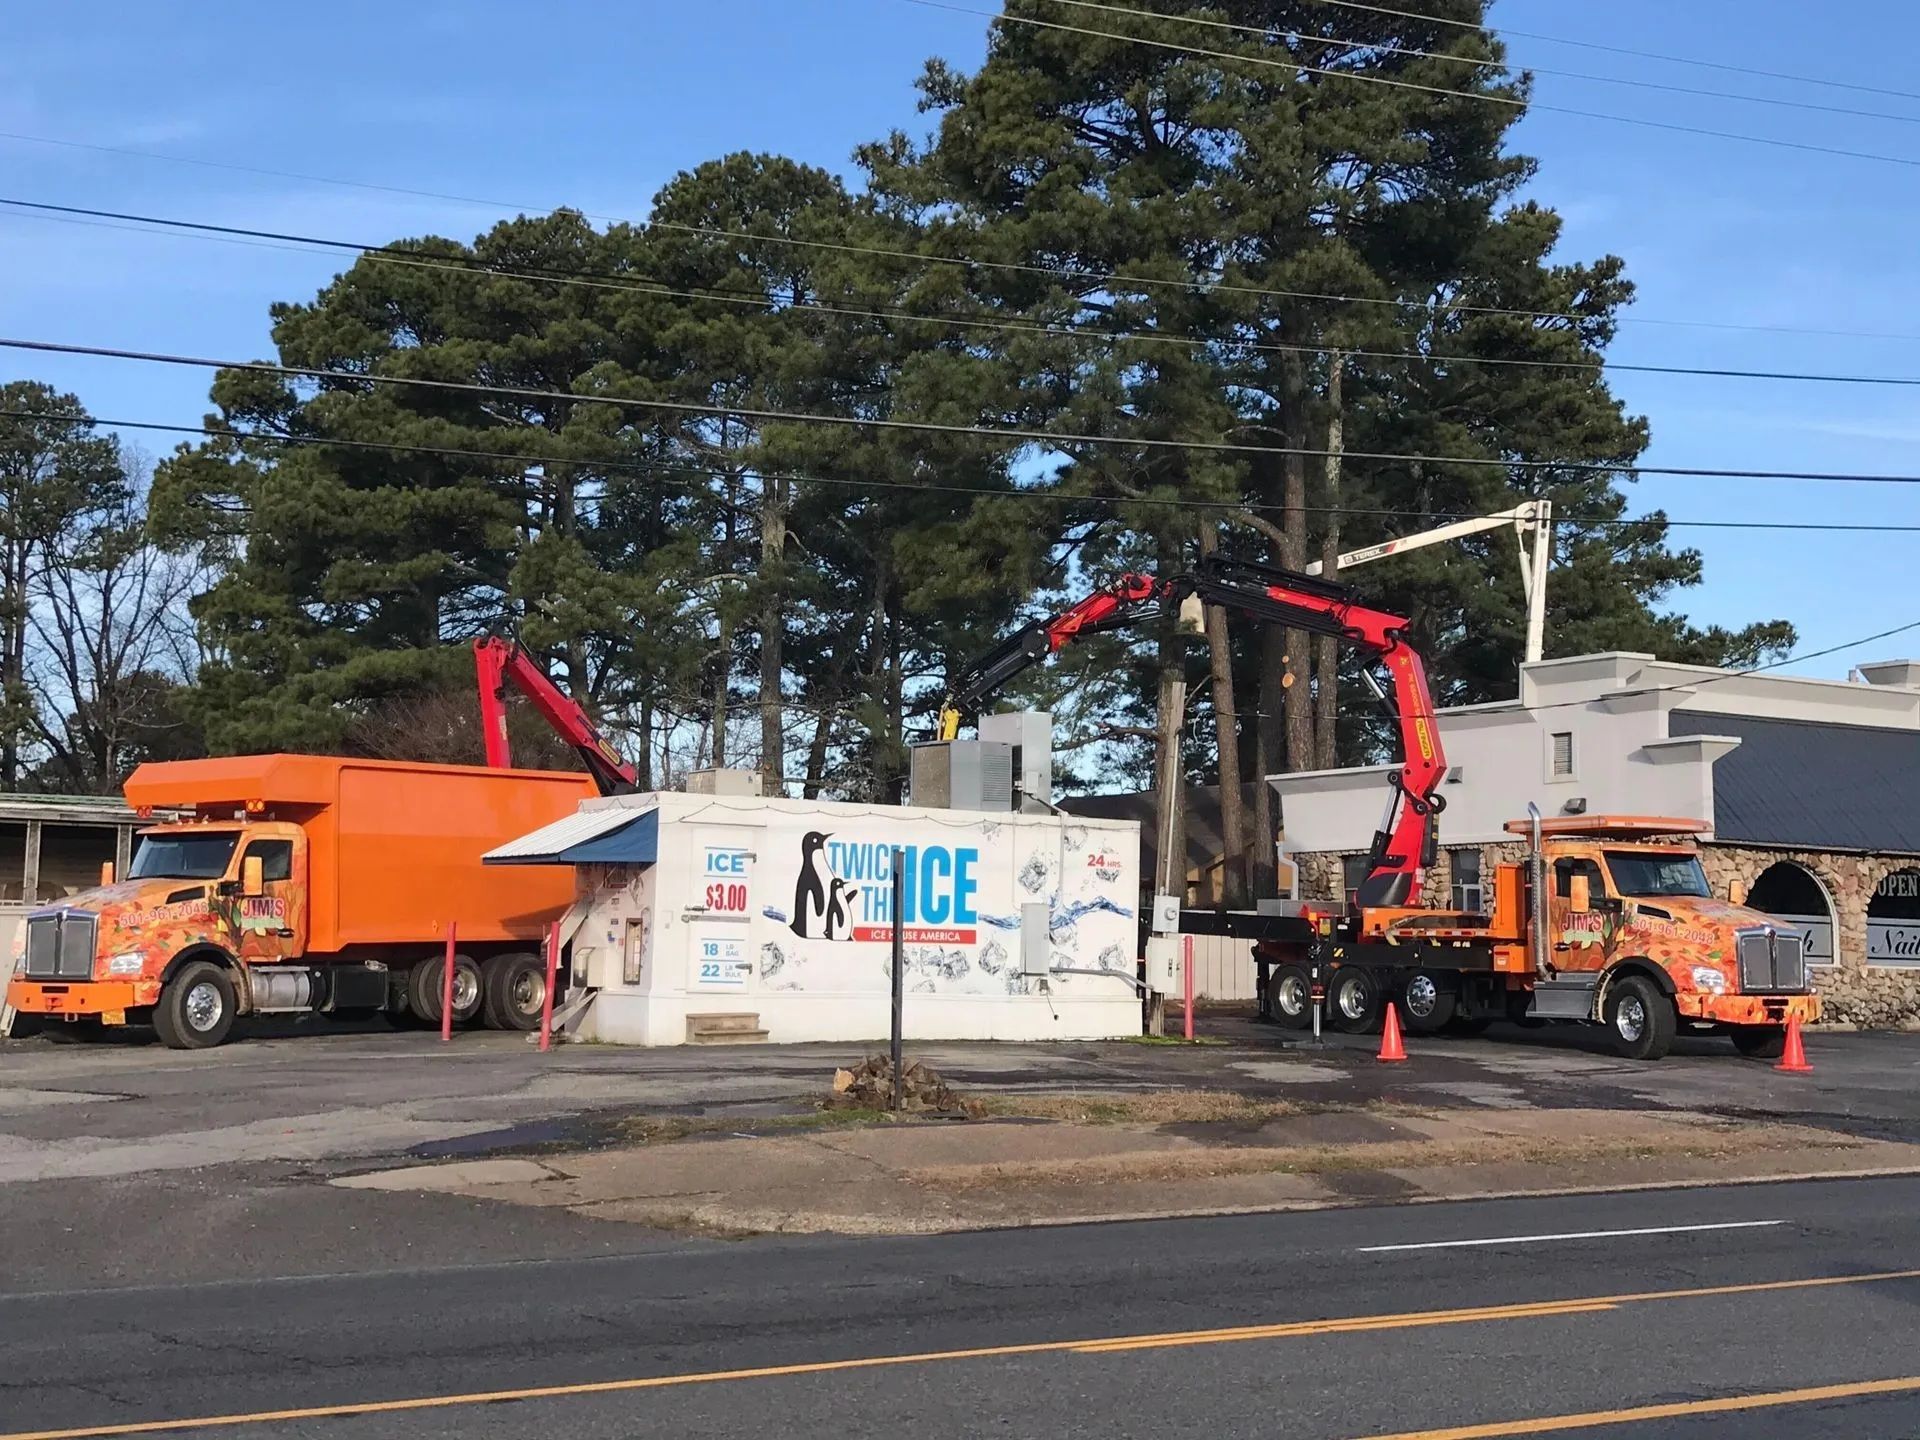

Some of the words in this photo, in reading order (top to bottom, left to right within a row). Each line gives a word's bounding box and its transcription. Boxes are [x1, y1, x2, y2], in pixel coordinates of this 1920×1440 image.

[707, 853, 744, 872] ICE
[1087, 854, 1105, 867] 24
[904, 845, 978, 924] ICE
[1877, 874, 1919, 897] OPEN
[706, 883, 747, 912] $3.00
[861, 886, 893, 922] TH
[242, 898, 284, 917] JIM'S
[871, 930, 886, 940] ICE
[889, 930, 918, 940] HUSE
[920, 931, 960, 942] AMERICA
[703, 943, 719, 956] 18
[701, 964, 720, 977] 22
